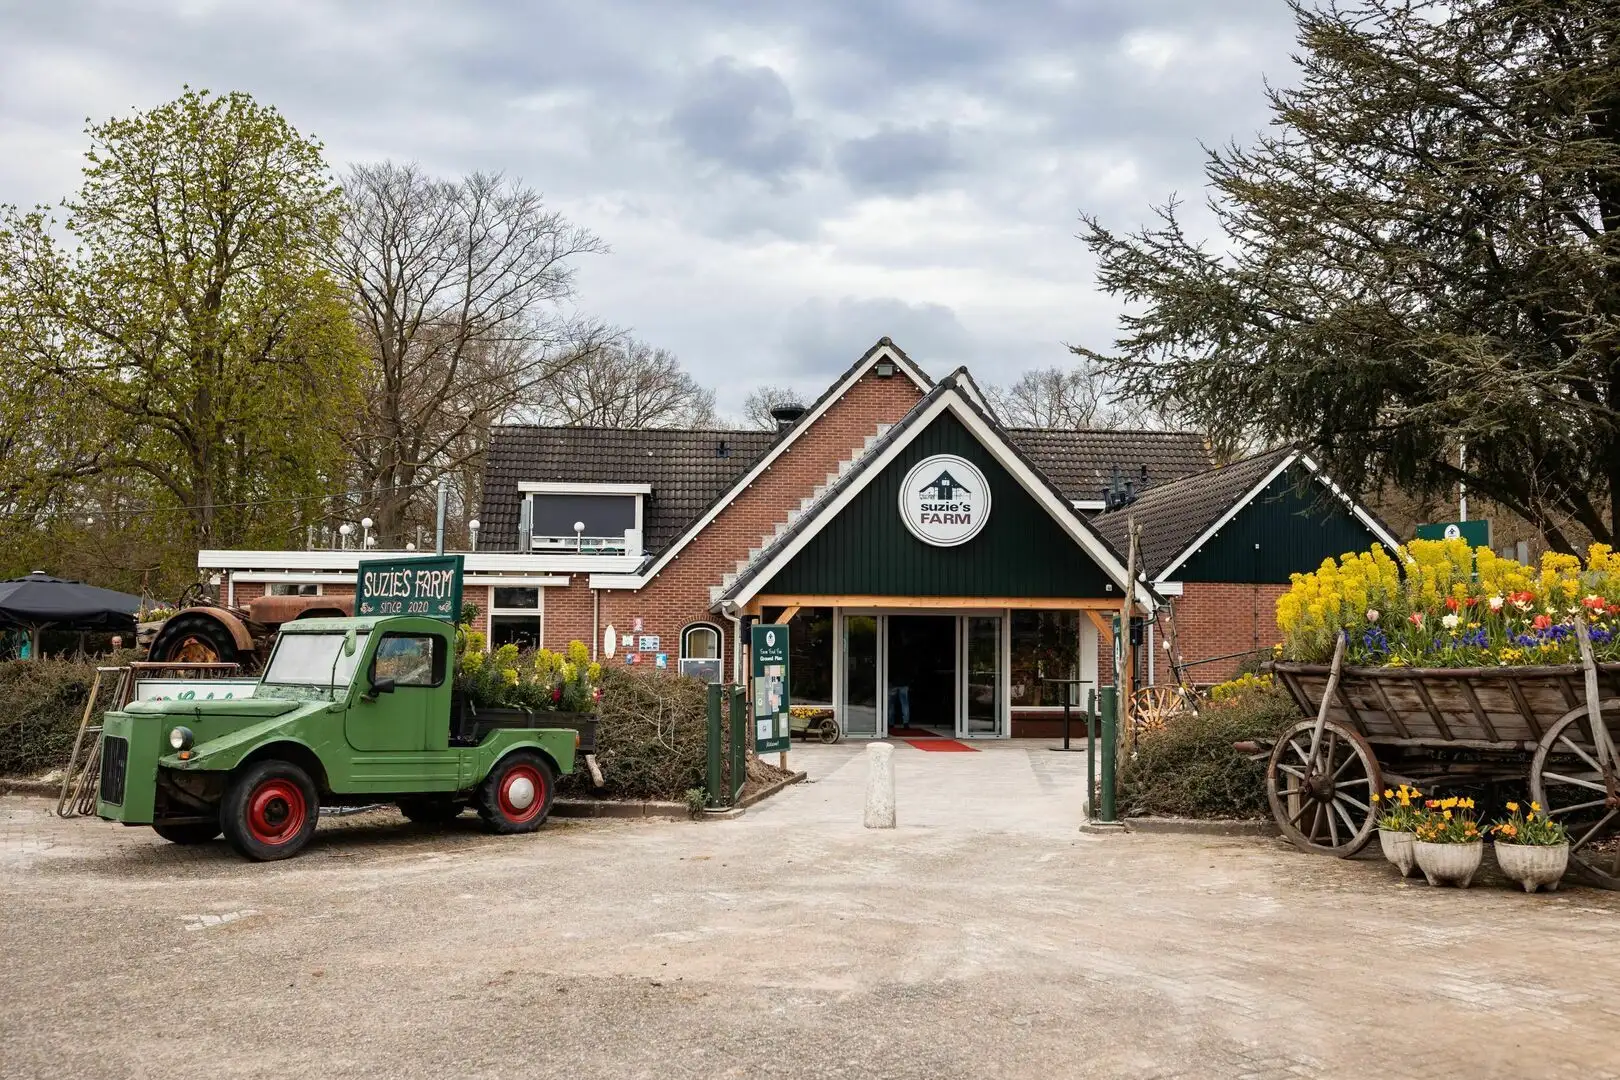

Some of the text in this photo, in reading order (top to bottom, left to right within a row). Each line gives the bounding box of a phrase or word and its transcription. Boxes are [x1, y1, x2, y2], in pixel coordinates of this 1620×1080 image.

[920, 502, 971, 512] suzie's
[920, 513, 971, 525] FARM
[415, 569, 455, 599] FARM
[407, 601, 429, 613] 2020
